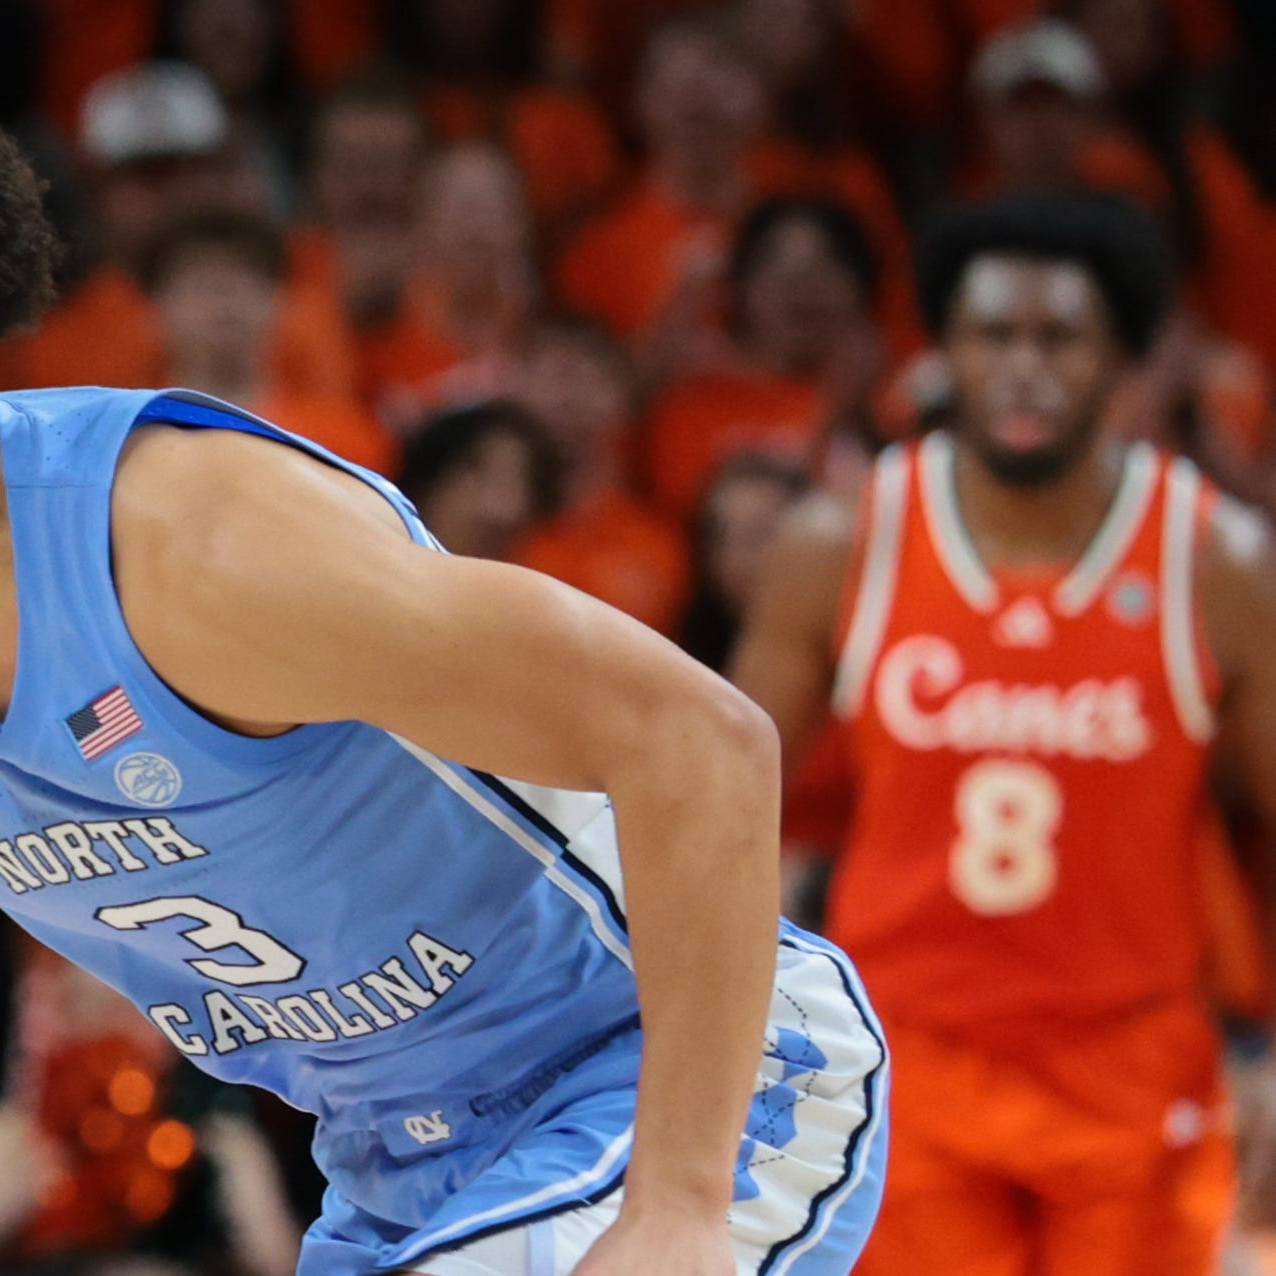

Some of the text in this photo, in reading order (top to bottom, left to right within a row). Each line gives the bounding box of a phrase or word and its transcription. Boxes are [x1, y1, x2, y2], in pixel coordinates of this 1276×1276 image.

[875, 635, 1154, 762] Canes
[949, 757, 1063, 918] 8
[93, 894, 309, 987] 3
[147, 930, 474, 1057] CAROLINA
